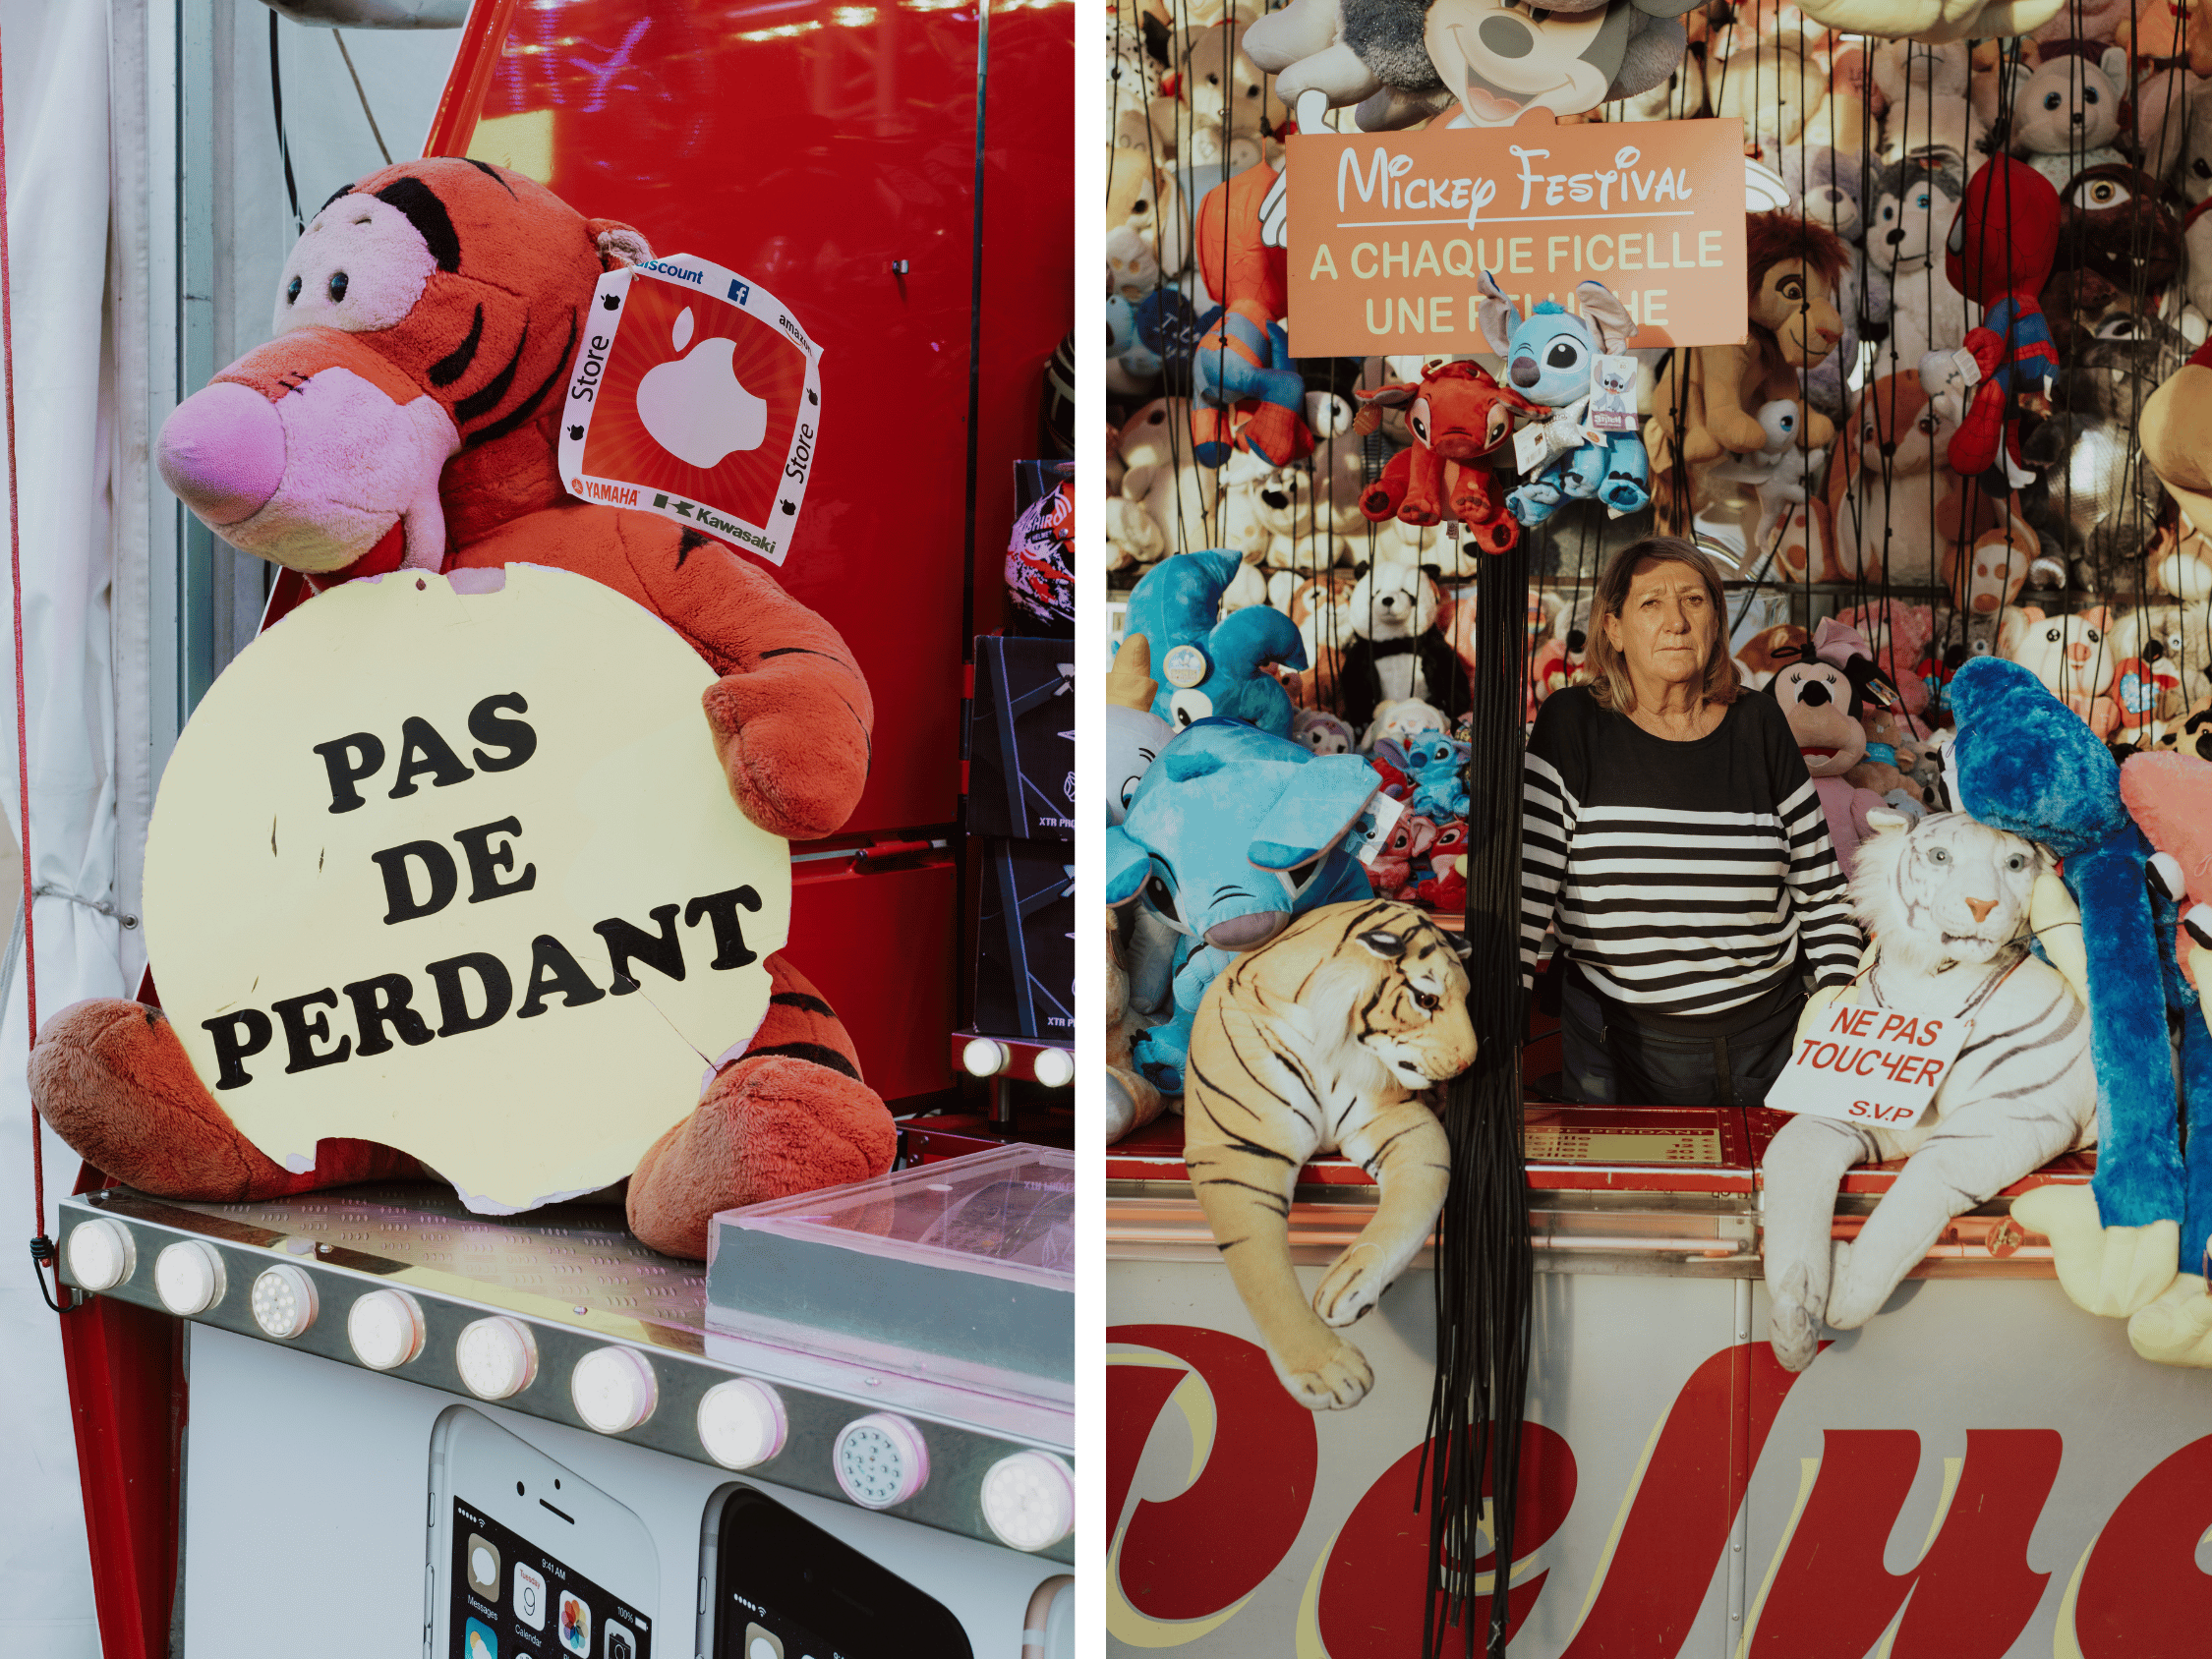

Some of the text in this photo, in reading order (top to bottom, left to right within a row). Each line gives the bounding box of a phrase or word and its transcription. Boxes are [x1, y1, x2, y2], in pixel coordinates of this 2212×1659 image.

[636, 259, 704, 285] iscount
[1310, 230, 1724, 281] A CHAQUE FICELLE
[1366, 297, 1455, 335] UNE
[779, 315, 813, 358] amazon
[571, 335, 610, 402] Store
[785, 423, 814, 485] Store
[585, 480, 638, 506] YAMAHA
[696, 507, 777, 555] Kawasaki
[312, 691, 538, 815] PAS
[1039, 817, 1058, 827] XTR
[371, 815, 537, 926] DE
[201, 884, 763, 1091] PERDANT
[1047, 1016, 1066, 1027] XTR
[1830, 1007, 1944, 1047] NE PAS
[1796, 1039, 1945, 1087] TOUCHER
[1848, 1101, 1914, 1121] S.V.P
[519, 1569, 541, 1590] Tuesday
[541, 1558, 566, 1580] 9:41 AM
[467, 1594, 498, 1621] Messages
[523, 1587, 536, 1616] 9
[616, 1606, 634, 1624] 100%
[515, 1624, 543, 1648] Calendar
